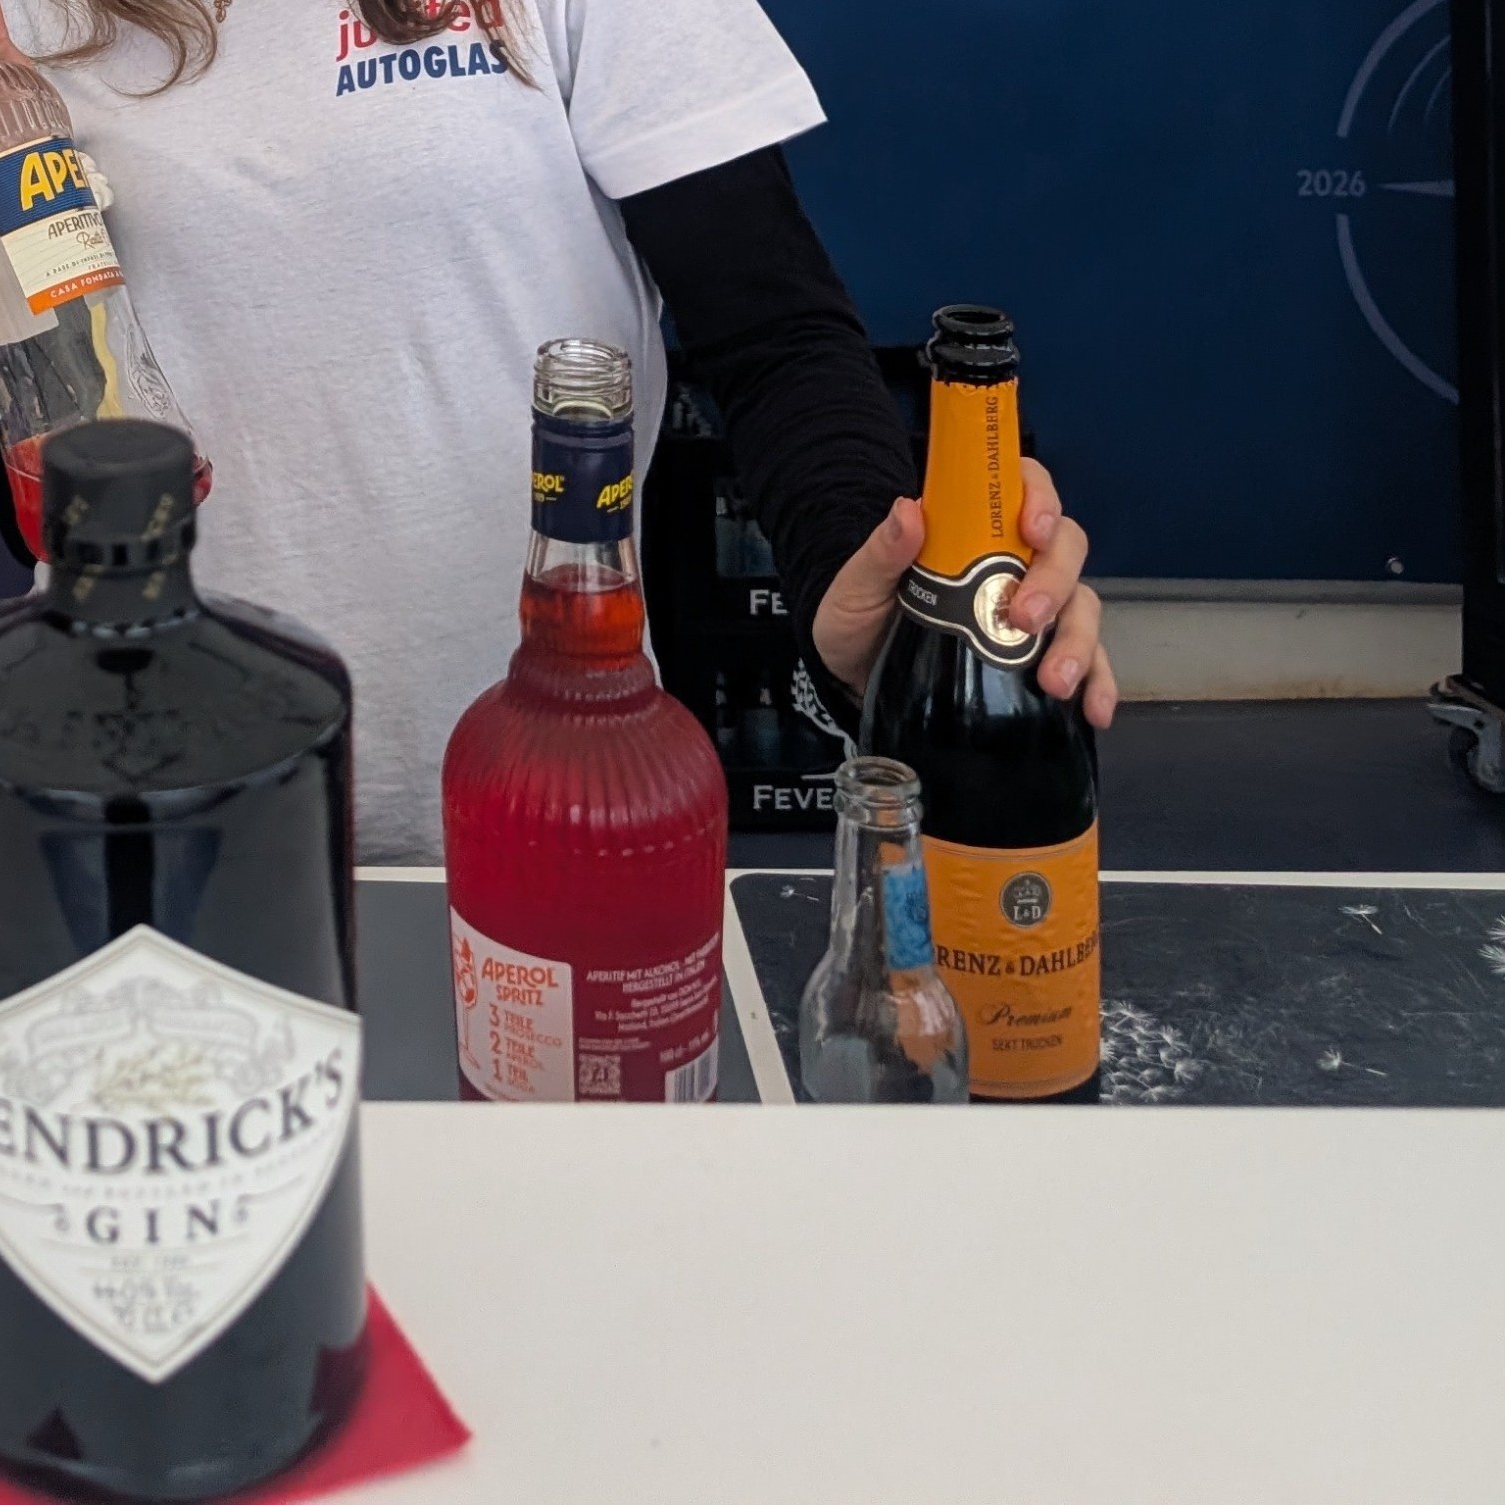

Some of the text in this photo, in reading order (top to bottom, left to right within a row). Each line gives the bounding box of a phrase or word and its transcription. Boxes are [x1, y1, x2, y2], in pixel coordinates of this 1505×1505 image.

[336, 40, 509, 97] AUTOGLAS
[20, 148, 90, 212] APE
[1296, 169, 1366, 197] 2026
[50, 281, 78, 298] CASA
[986, 396, 1001, 472] DAHLBERG
[990, 481, 1004, 538] LORENZ
[753, 785, 834, 810] FEVE
[481, 957, 559, 988] APEROL
[933, 944, 1001, 976] RENZ
[497, 984, 544, 1006] SPRITZ
[489, 1003, 500, 1027] 3
[980, 1003, 1072, 1027] Premium
[489, 1031, 501, 1055] 2
[493, 1058, 503, 1082] 1
[86, 1198, 220, 1245] GIN
